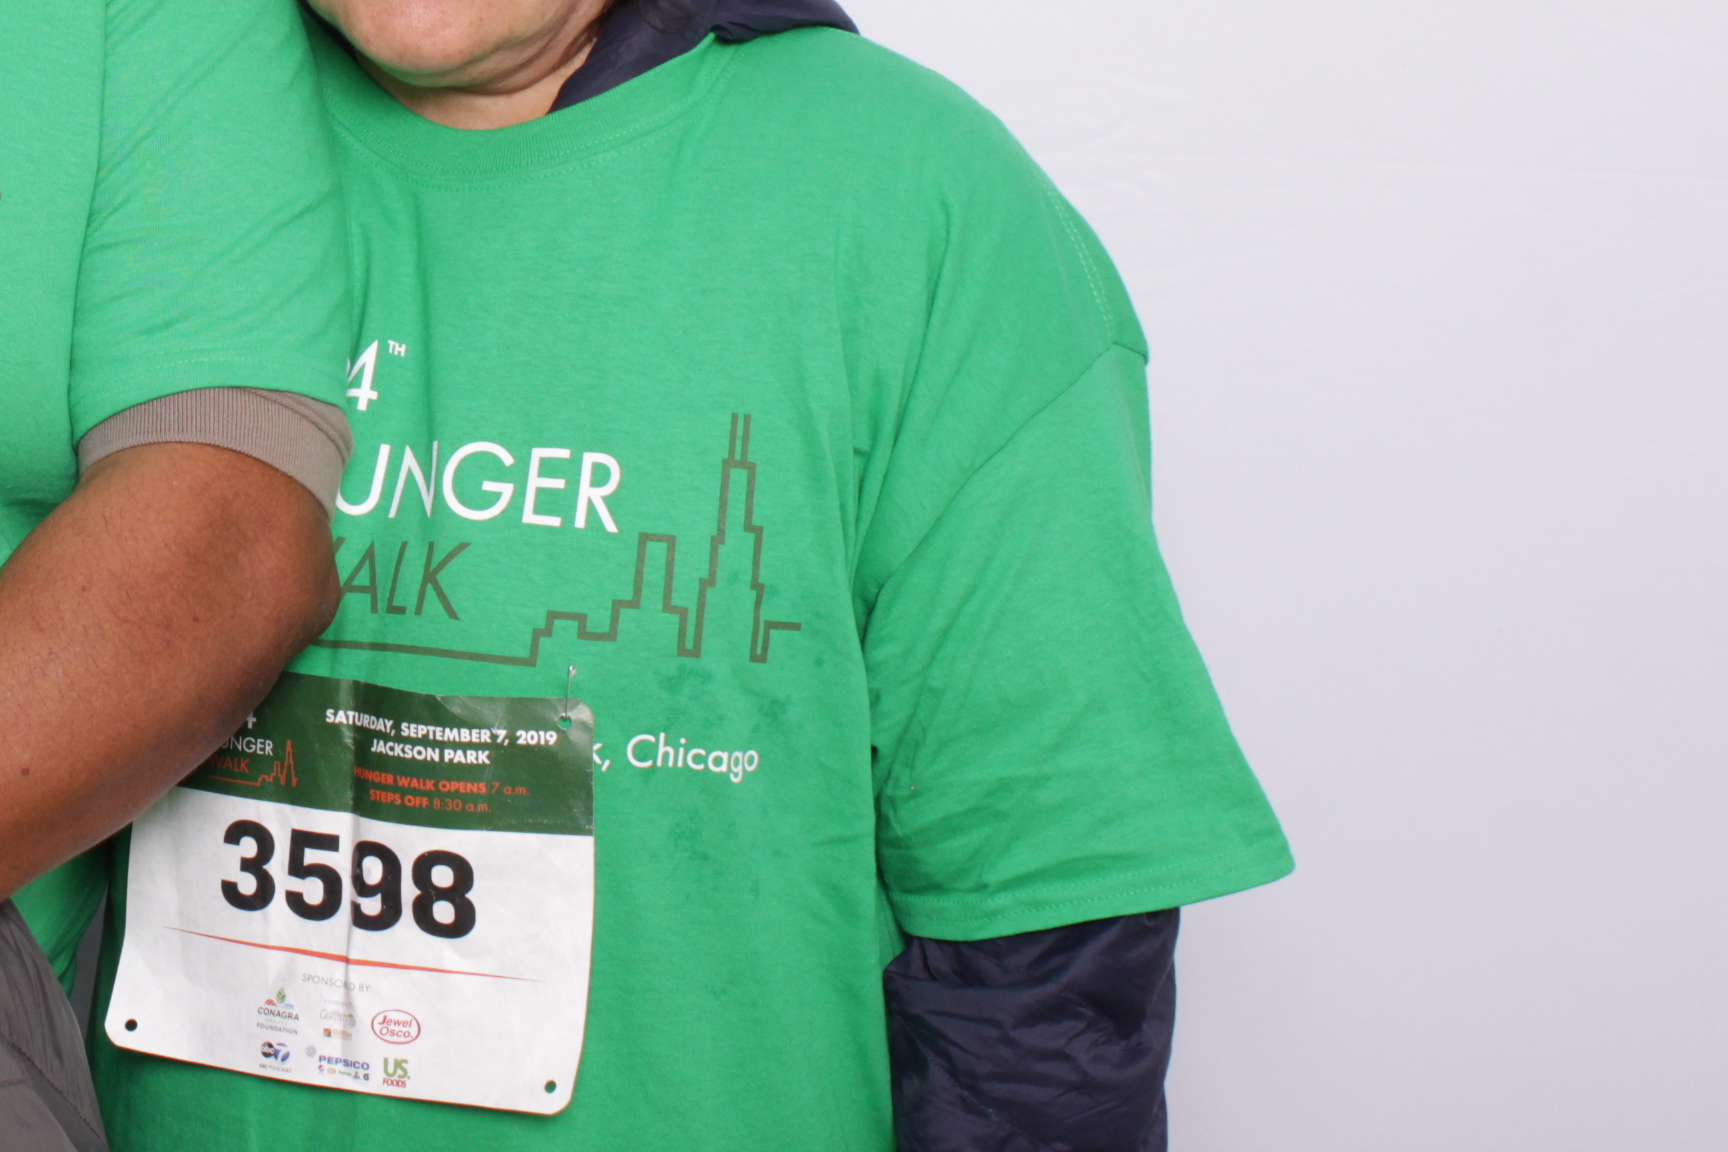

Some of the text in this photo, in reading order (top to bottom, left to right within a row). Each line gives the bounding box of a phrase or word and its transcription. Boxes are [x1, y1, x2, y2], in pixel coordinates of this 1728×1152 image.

[334, 440, 622, 534] UNGER
[328, 536, 472, 621] ALK
[325, 708, 397, 737] SATURDAY,
[400, 722, 492, 744] SEPTEMBER
[516, 730, 559, 746] 2019
[221, 735, 274, 756] UNGER
[370, 738, 491, 765] JACKSON PARK
[626, 732, 760, 784] Chicago
[353, 765, 530, 796] HUNGER WALK OPENS 7 a.m.
[369, 789, 491, 813] STEPS OFF 8:30 a.m.
[220, 819, 477, 940] 3598
[257, 1006, 300, 1022] CONAGRA
[378, 1014, 413, 1029] Jewel
[256, 1022, 298, 1035] FOUNDATION
[318, 1054, 370, 1071] PEPSICO
[382, 1077, 408, 1088] FOODS
